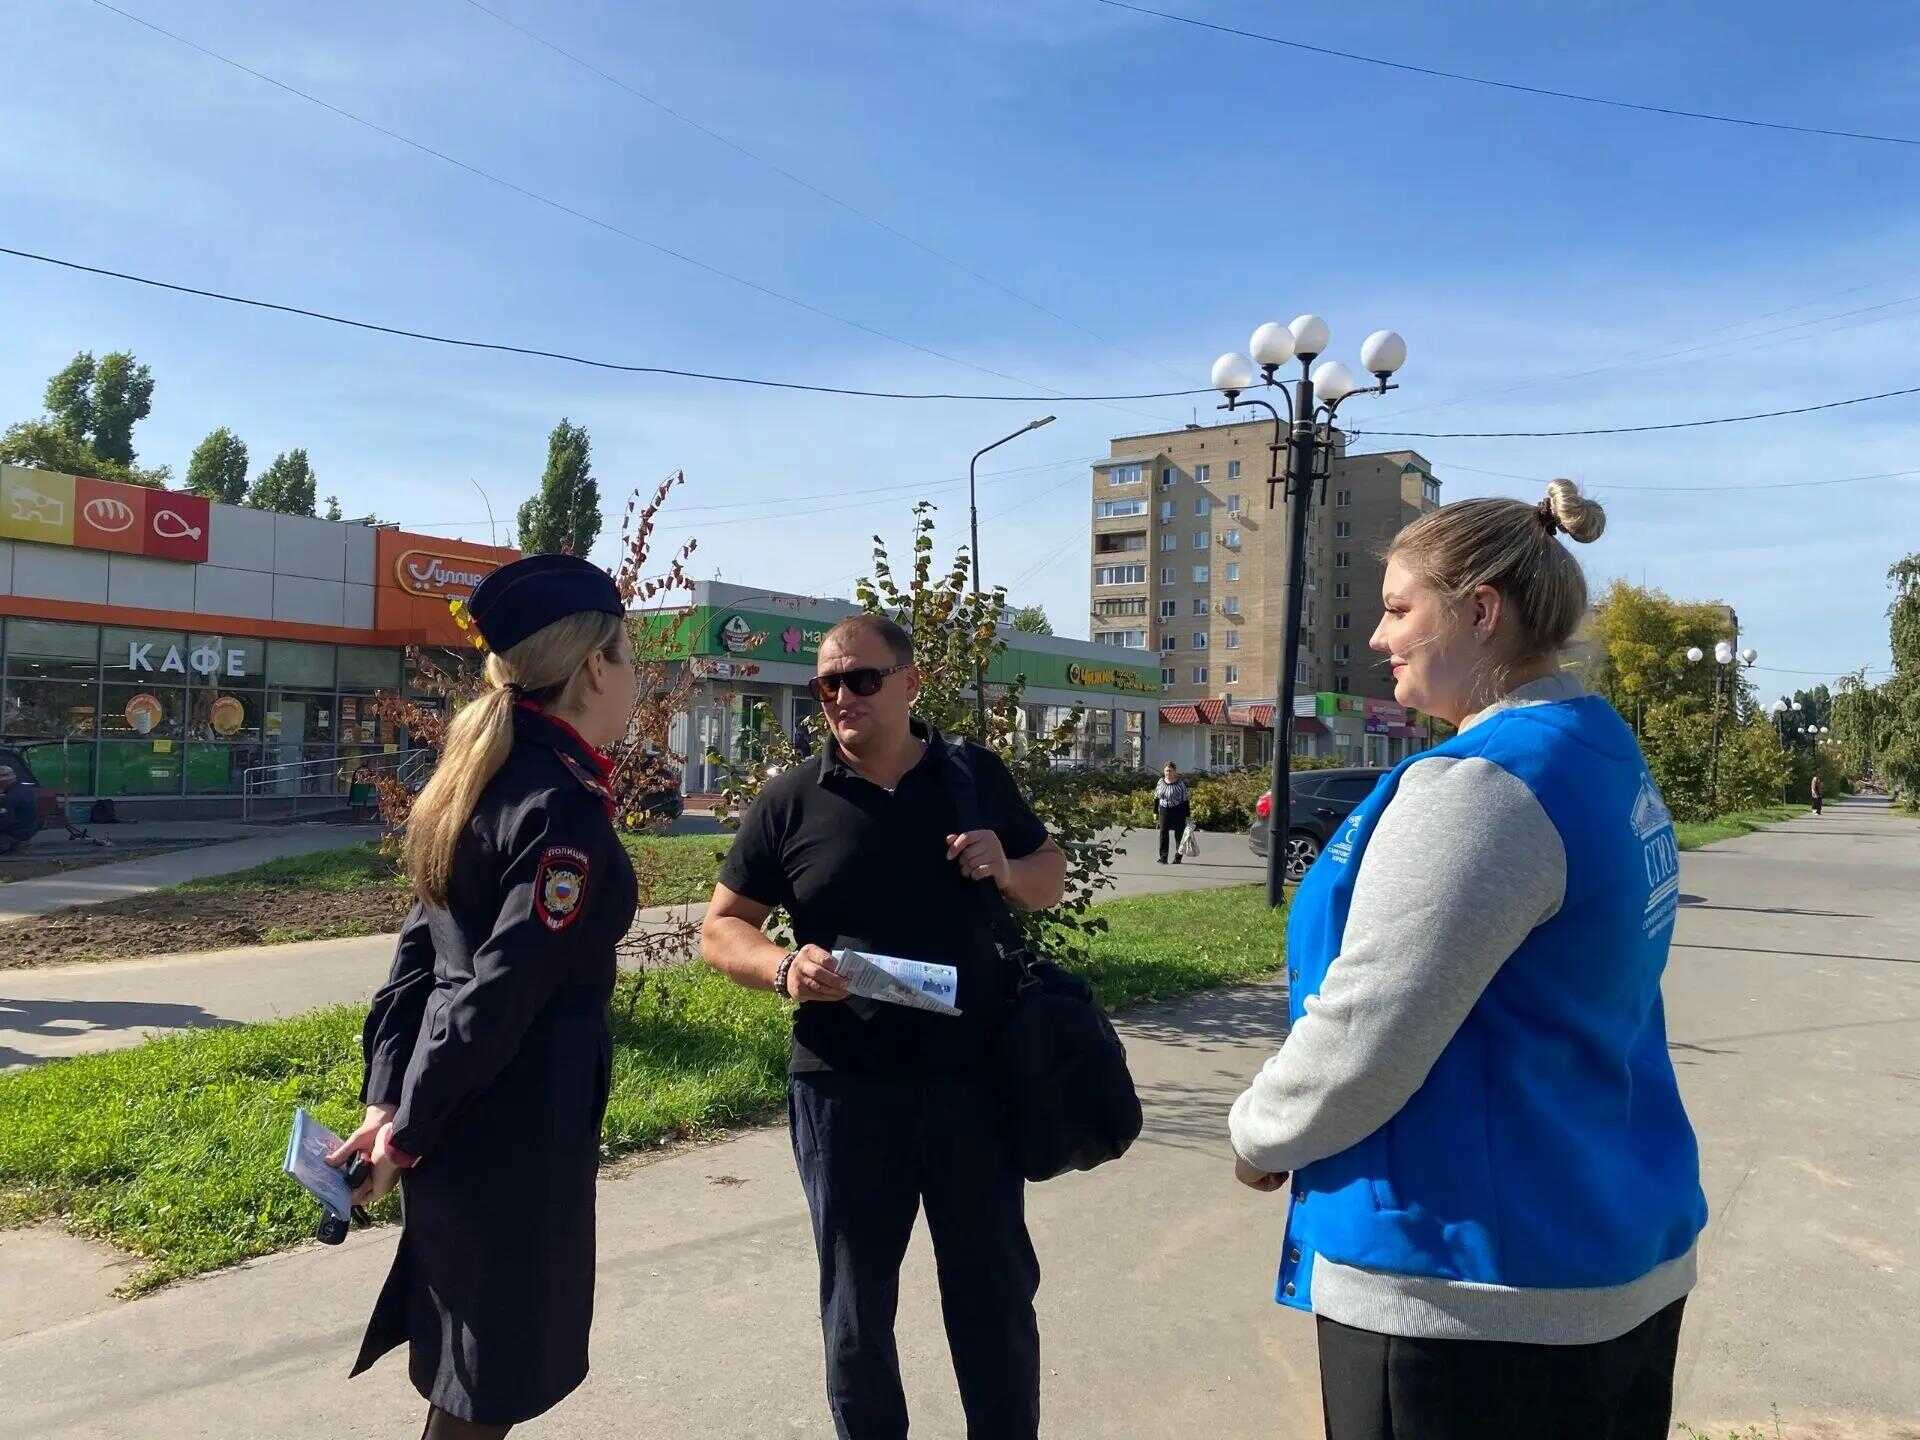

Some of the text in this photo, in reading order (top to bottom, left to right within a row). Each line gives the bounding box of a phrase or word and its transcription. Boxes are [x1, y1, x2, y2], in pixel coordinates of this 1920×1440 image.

[409, 559, 483, 587] Гуллив
[128, 640, 246, 677] КАФЕ
[545, 847, 588, 865] ПОЛИЦИЯ
